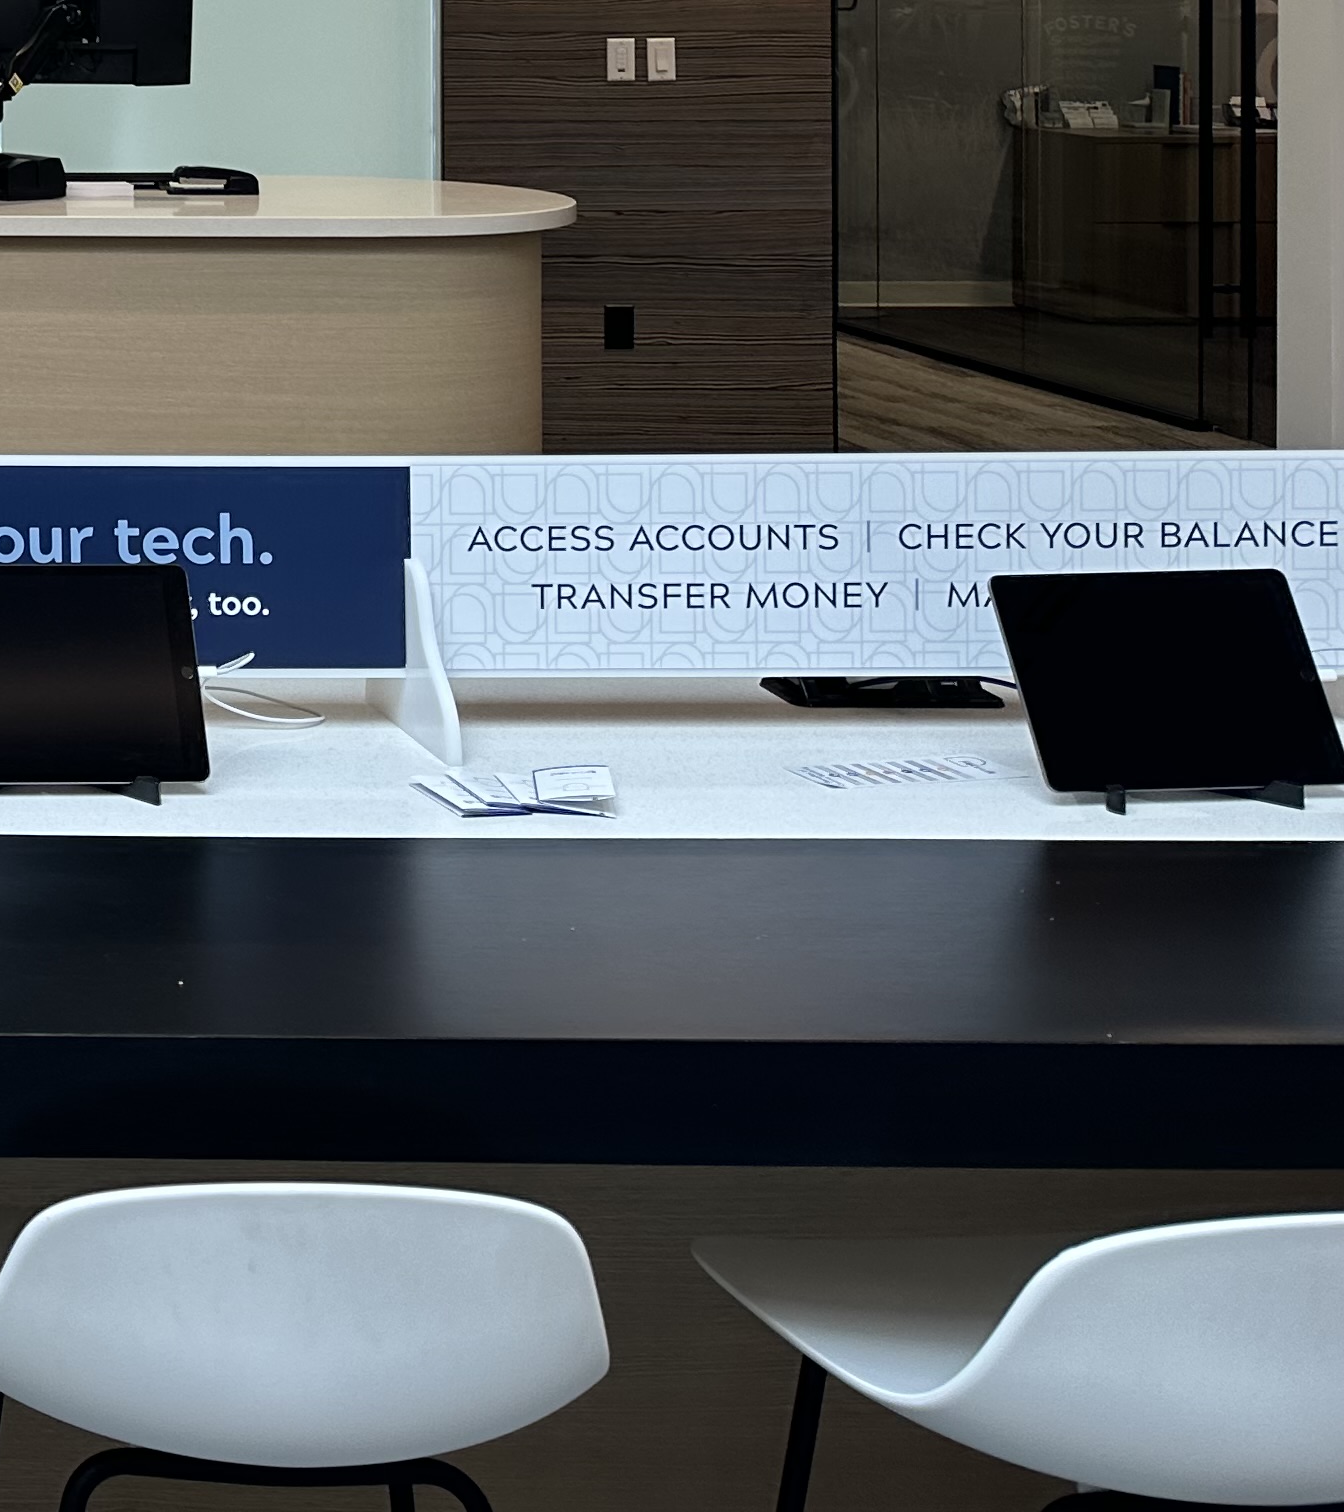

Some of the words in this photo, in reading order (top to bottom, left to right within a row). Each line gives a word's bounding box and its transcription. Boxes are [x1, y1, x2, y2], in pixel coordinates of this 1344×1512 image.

[1043, 14, 1137, 37] FOSTER'S
[113, 512, 274, 566] tech.
[467, 525, 615, 552] ACCESS
[629, 523, 839, 552] ACCOUNTS
[898, 522, 1027, 550] CHECK
[1039, 522, 1145, 549] YOUR
[1161, 520, 1339, 548] BALANCE
[207, 592, 270, 616] too.
[531, 582, 731, 610] TRANSFER
[746, 581, 889, 609] MONEY
